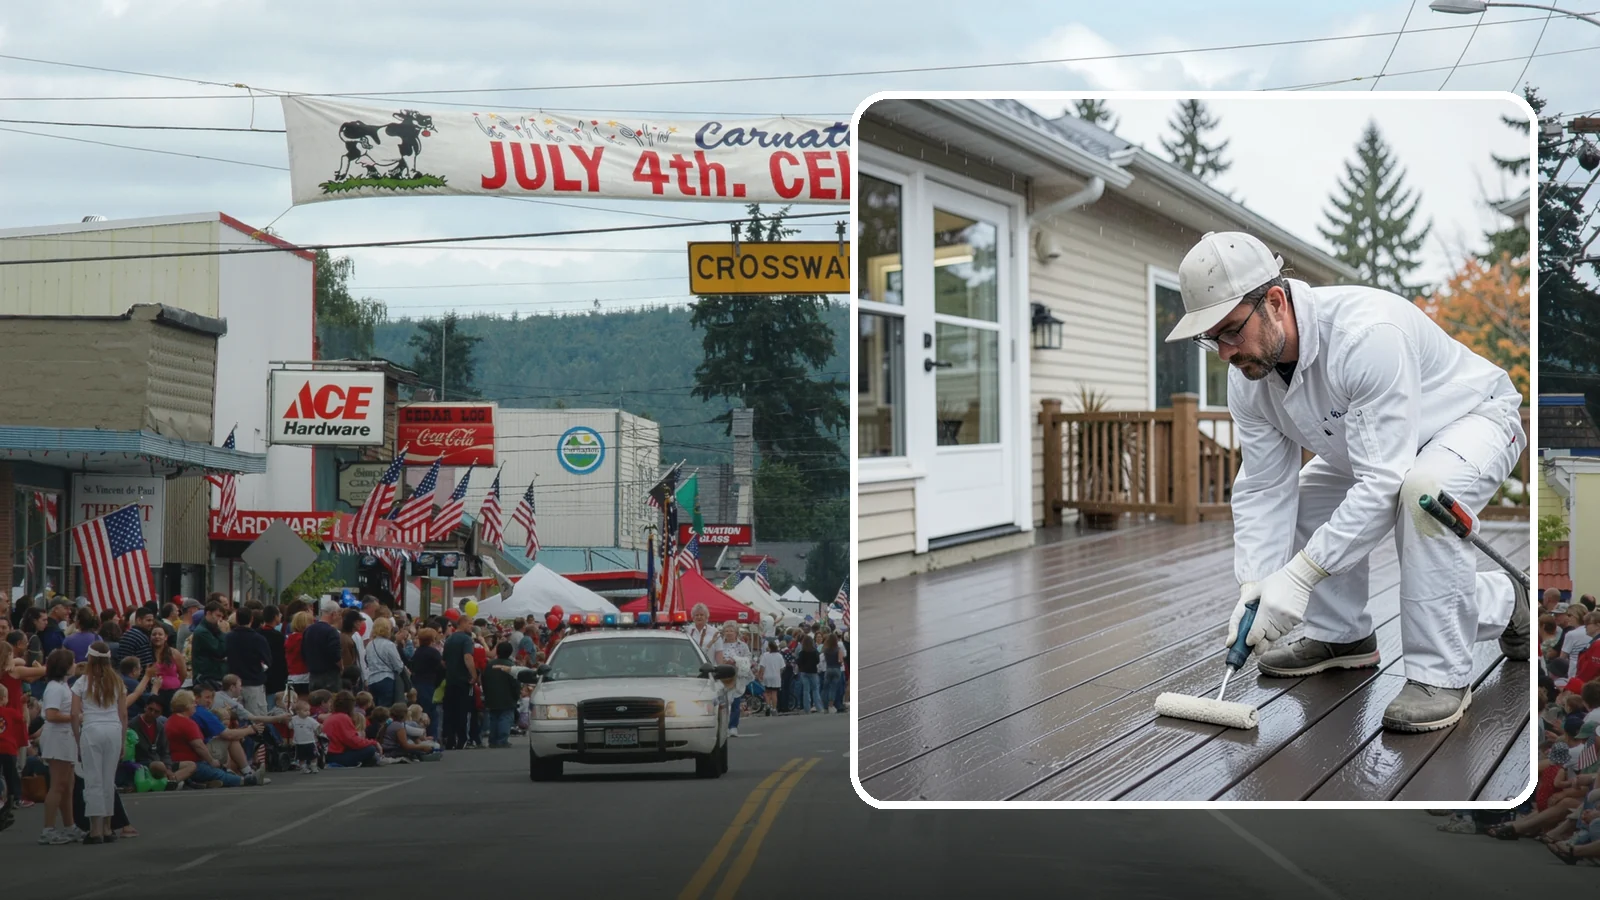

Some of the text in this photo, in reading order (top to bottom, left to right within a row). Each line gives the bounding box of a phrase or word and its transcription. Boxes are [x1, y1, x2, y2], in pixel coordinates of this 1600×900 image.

[481, 141, 604, 192] JULY
[632, 150, 746, 197] 4th.
[696, 254, 850, 280] CROSSWA
[282, 380, 373, 420] ACE
[405, 409, 485, 421] CEDAR LOG
[283, 420, 371, 436] Hardware
[83, 484, 155, 495] St. Vincent de Paul
[688, 526, 742, 535] CRNATION
[699, 535, 730, 544] GLASS
